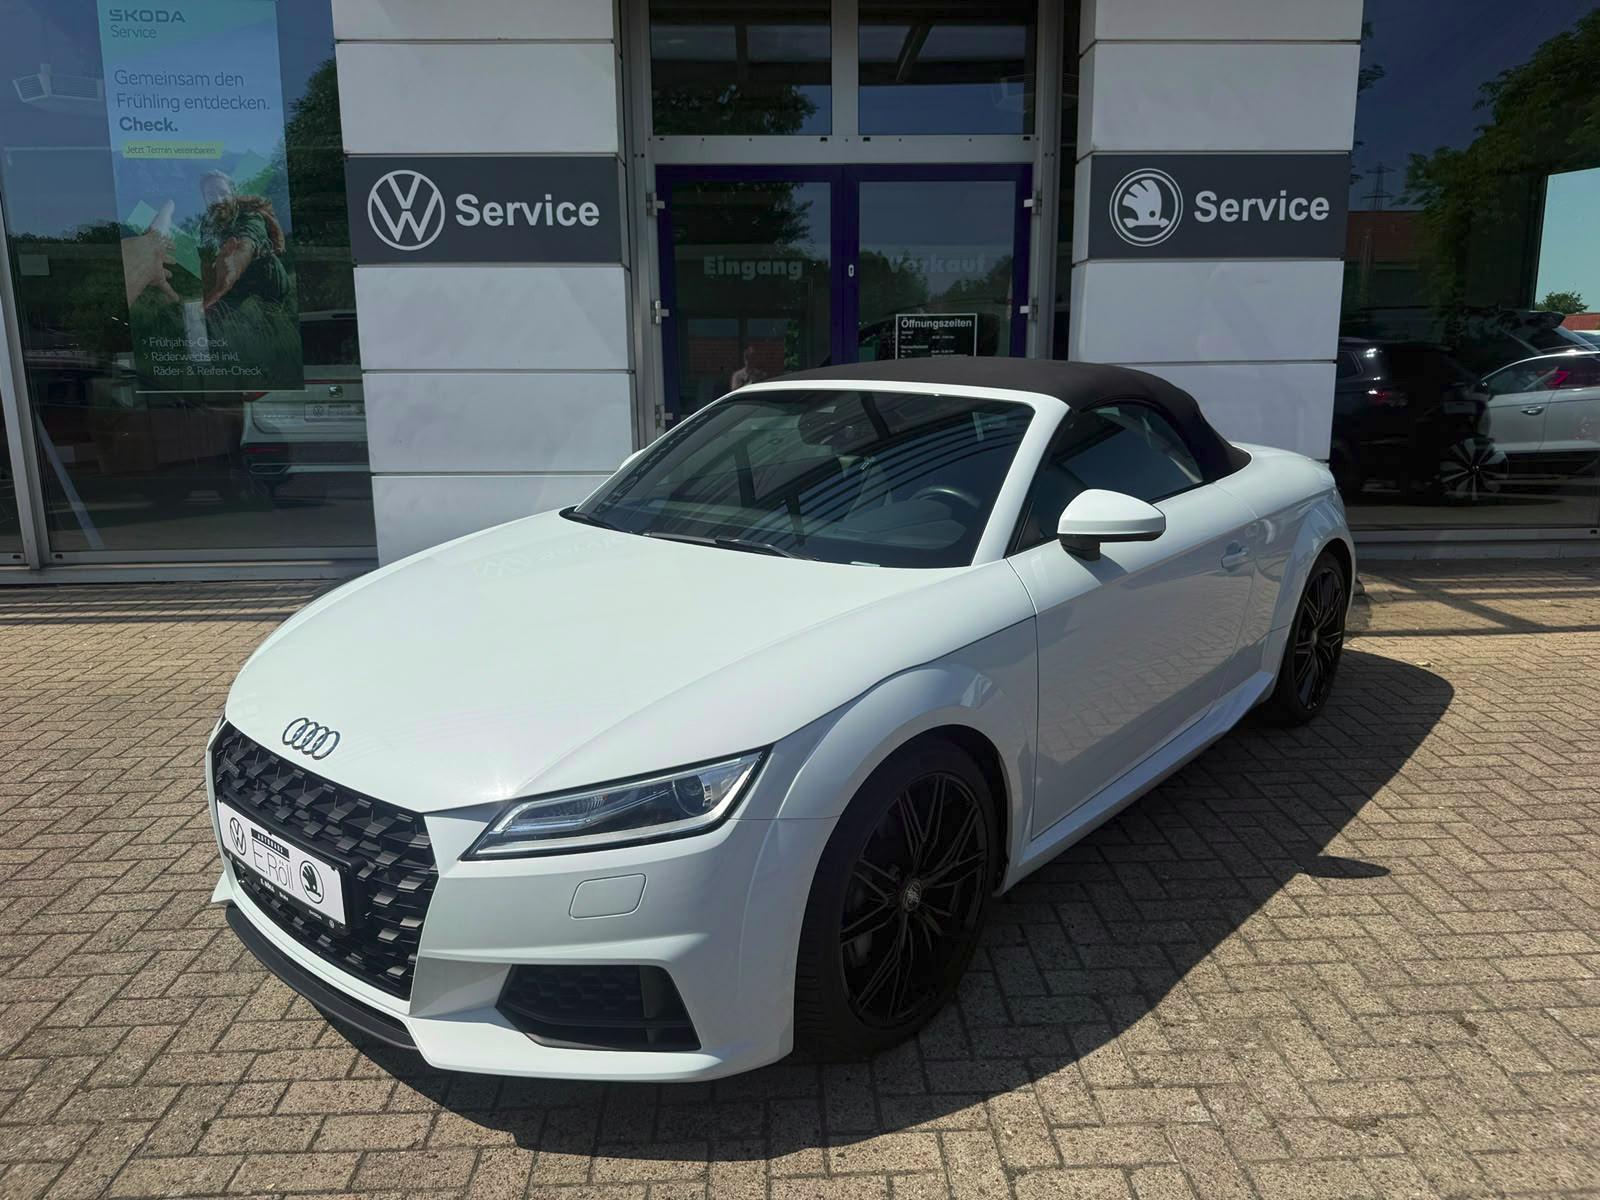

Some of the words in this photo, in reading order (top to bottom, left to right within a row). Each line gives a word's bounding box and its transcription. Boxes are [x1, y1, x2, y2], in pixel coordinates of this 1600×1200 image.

[111, 25, 157, 39] Service
[114, 69, 210, 87] Gemeinsam
[214, 72, 244, 87] den
[117, 92, 180, 113] Frühling
[184, 95, 270, 110] entdecken.
[119, 116, 178, 132] Check.
[455, 193, 600, 227] Service
[1194, 190, 1330, 223] Service
[703, 255, 803, 281] Eingang
[900, 317, 972, 330] Öffnungszeiten
